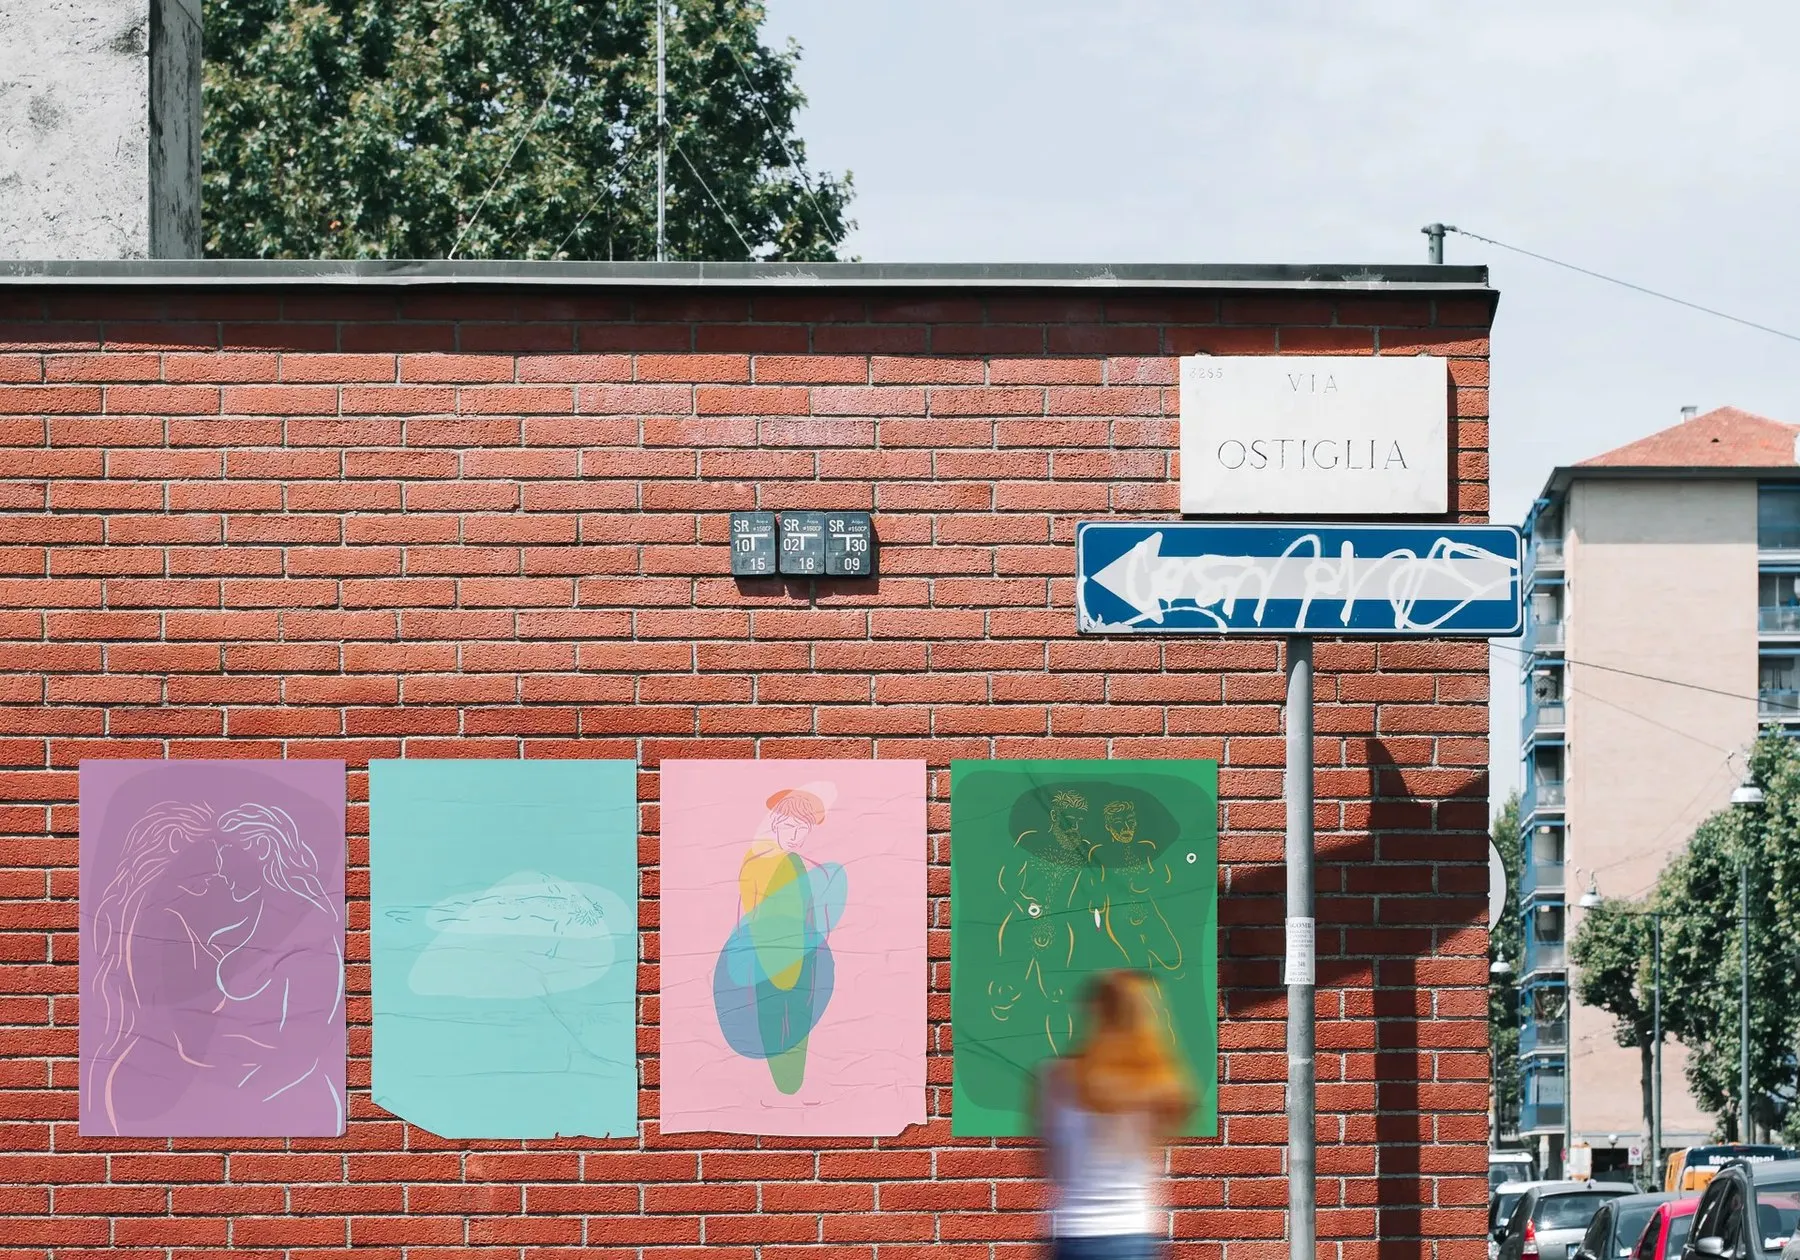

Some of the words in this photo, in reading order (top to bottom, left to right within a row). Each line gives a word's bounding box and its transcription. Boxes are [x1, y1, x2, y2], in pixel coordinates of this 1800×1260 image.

[1287, 373, 1338, 393] VIA
[1217, 439, 1409, 470] OSTIGLIA
[733, 519, 749, 532] SR
[783, 518, 799, 532] SR
[829, 519, 845, 532] SR
[735, 539, 750, 552] 10
[783, 538, 800, 551] 02
[851, 539, 867, 552] 30
[750, 557, 765, 570] 15
[799, 557, 814, 570] 18
[844, 557, 860, 570] 09
